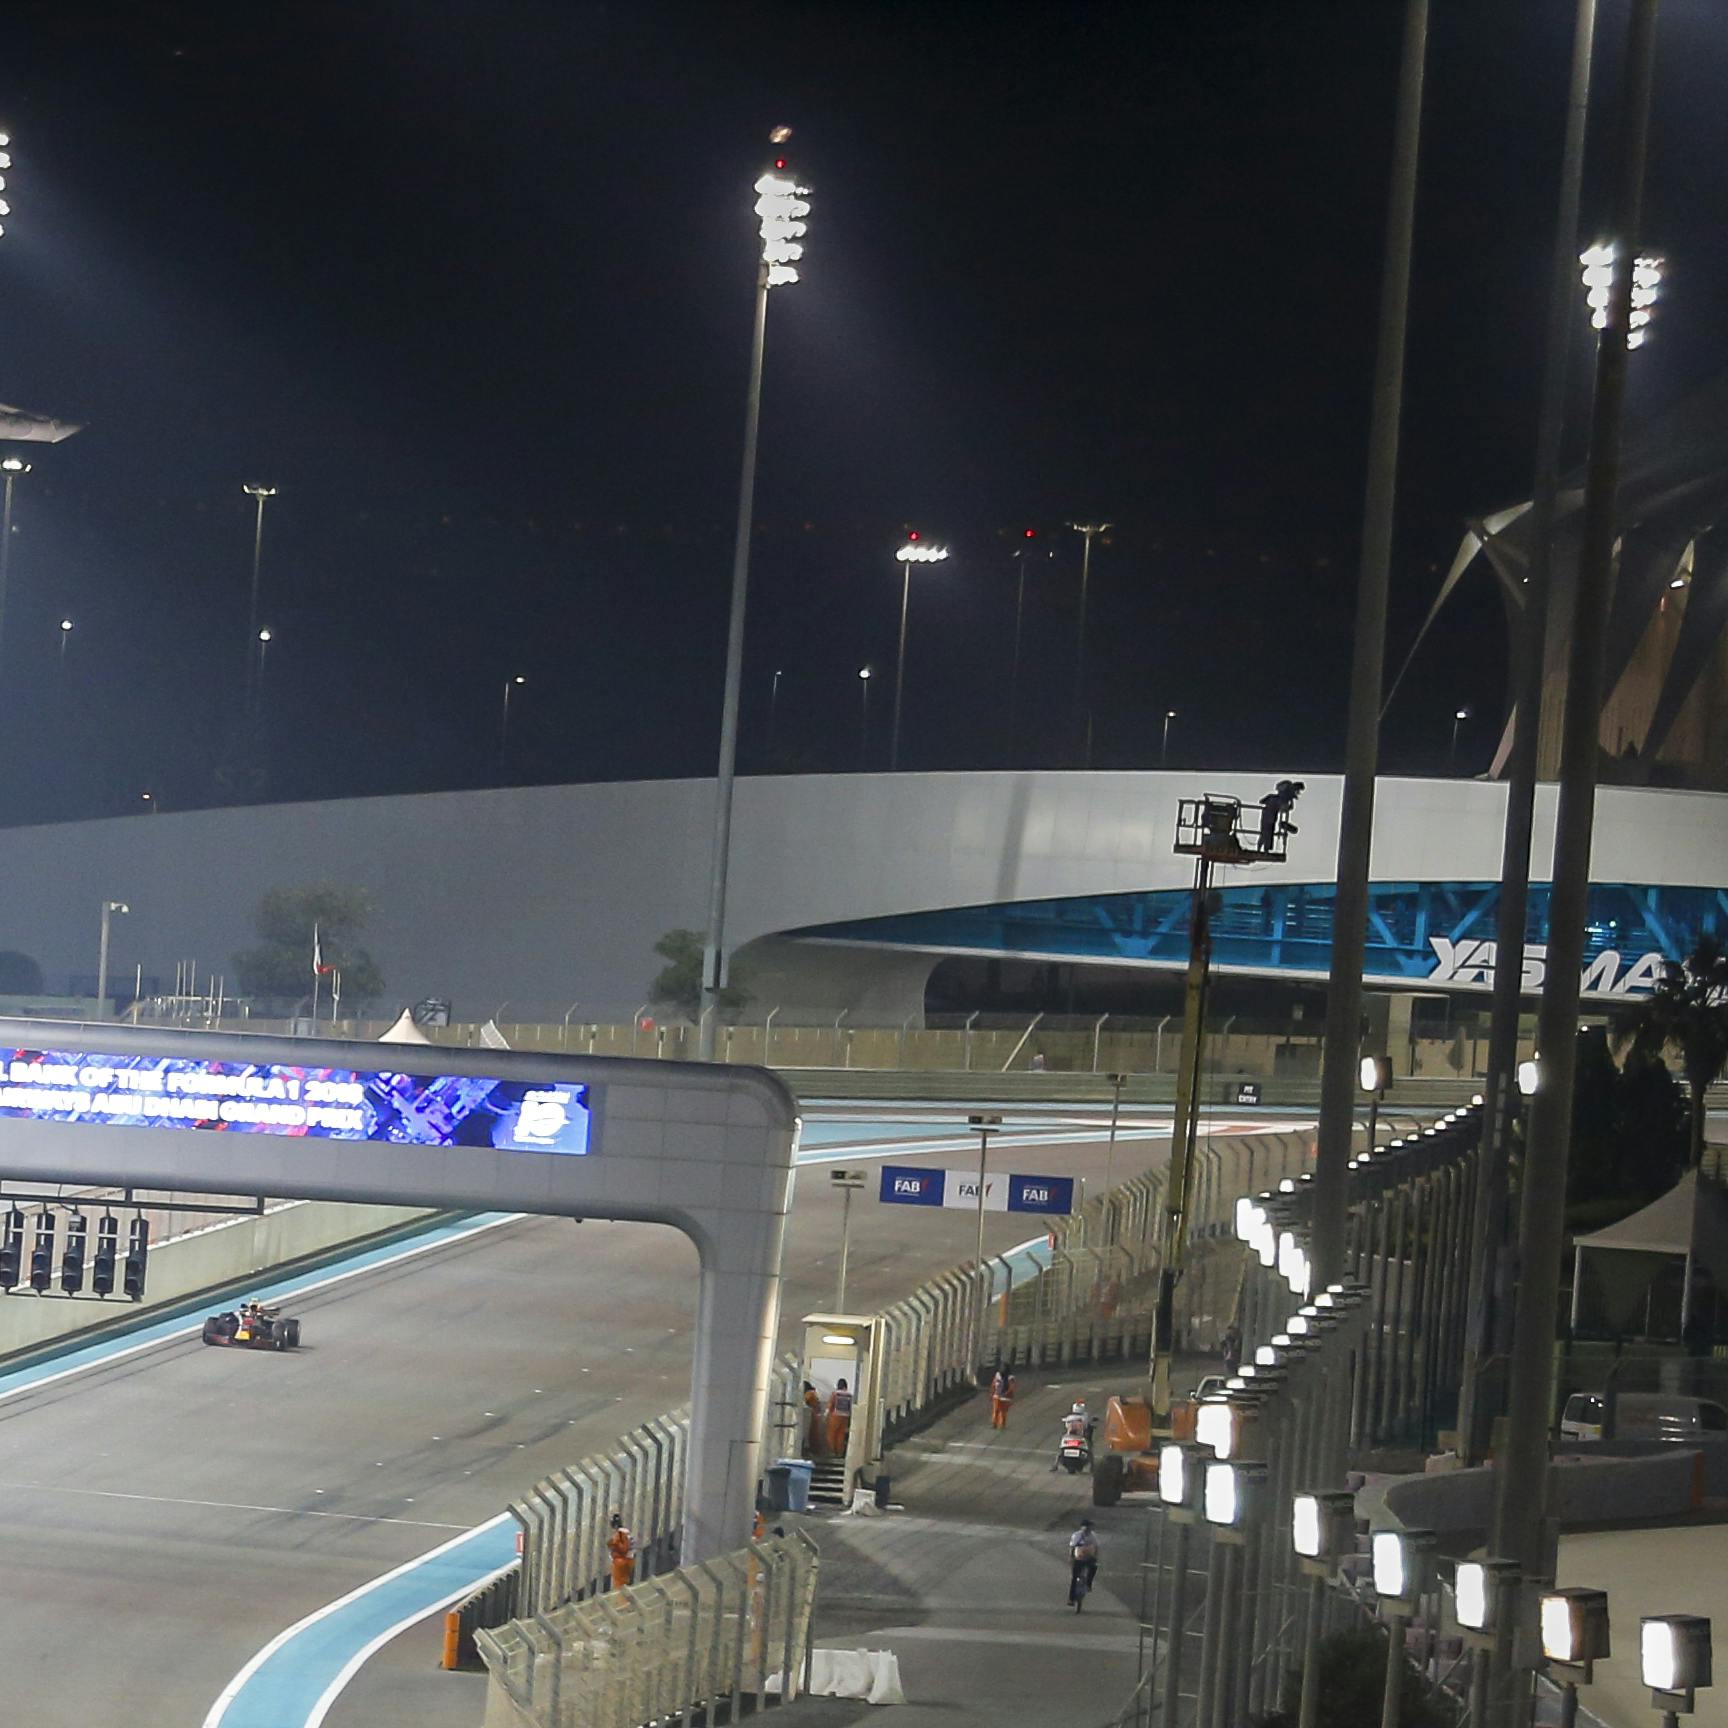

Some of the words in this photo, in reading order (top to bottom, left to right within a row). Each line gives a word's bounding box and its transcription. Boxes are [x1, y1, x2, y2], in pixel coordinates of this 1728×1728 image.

[9, 1062, 78, 1085] BANK
[79, 1066, 116, 1087] OF
[167, 1073, 286, 1098] FORMULA
[219, 1100, 306, 1126] GRAND
